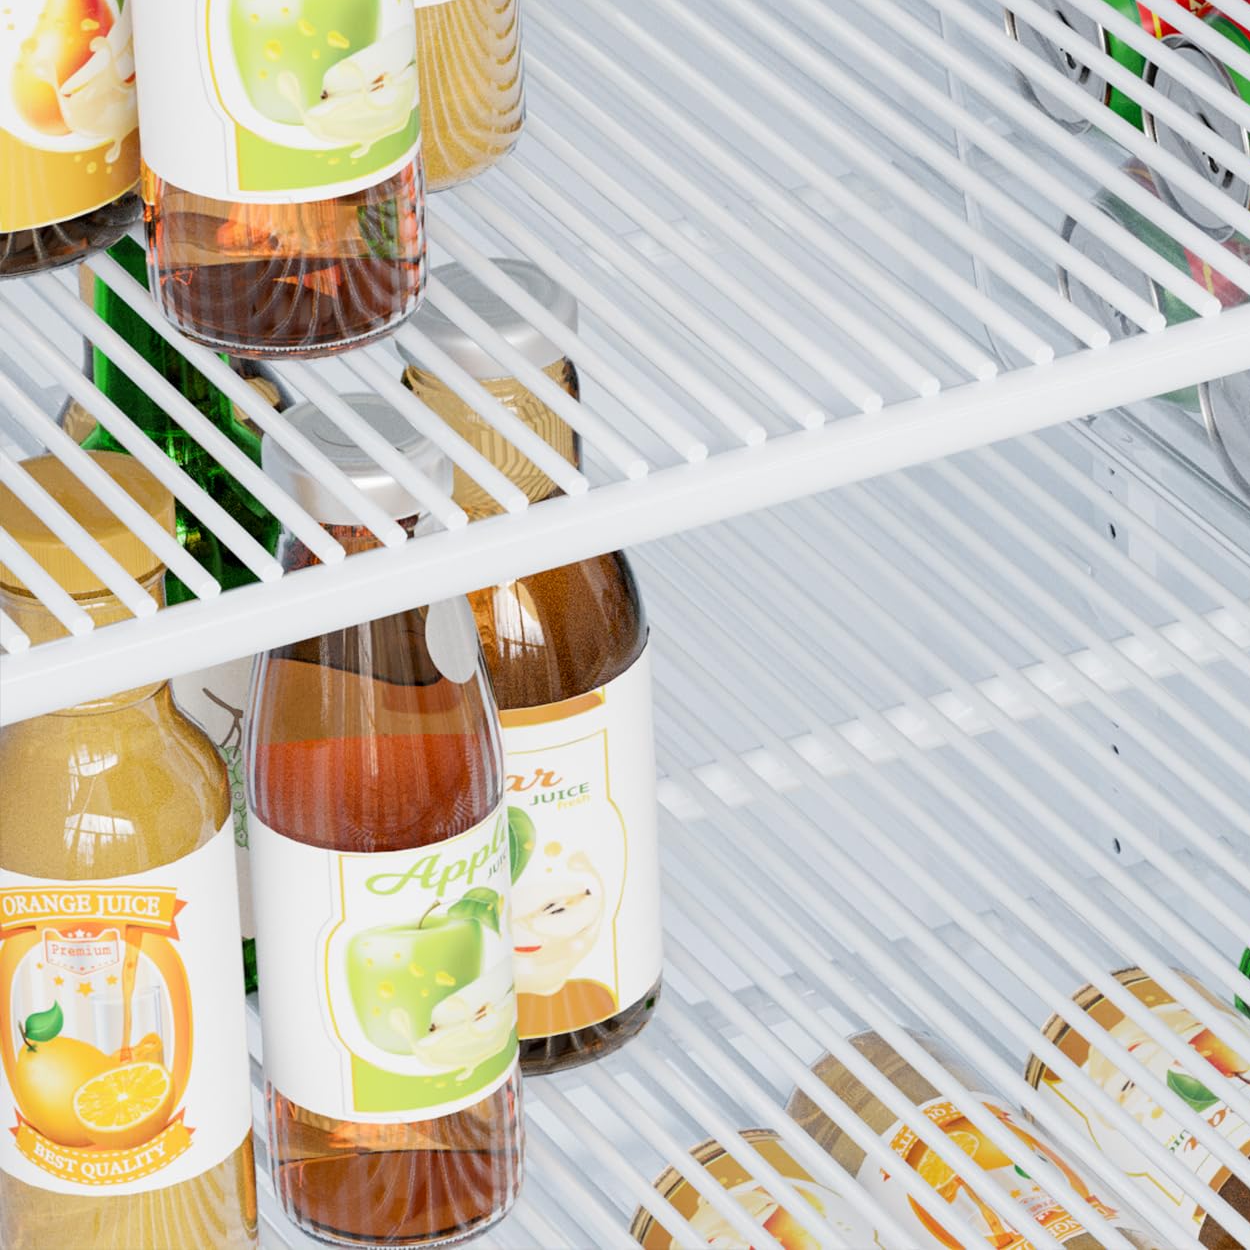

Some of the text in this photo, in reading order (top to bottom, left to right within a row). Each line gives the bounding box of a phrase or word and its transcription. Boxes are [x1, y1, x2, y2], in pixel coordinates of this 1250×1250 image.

[529, 782, 591, 807] JUICE
[2, 894, 161, 918] ORANGE JUICE
[51, 943, 113, 957] Premium
[33, 1140, 168, 1179] BEST QUALITY
